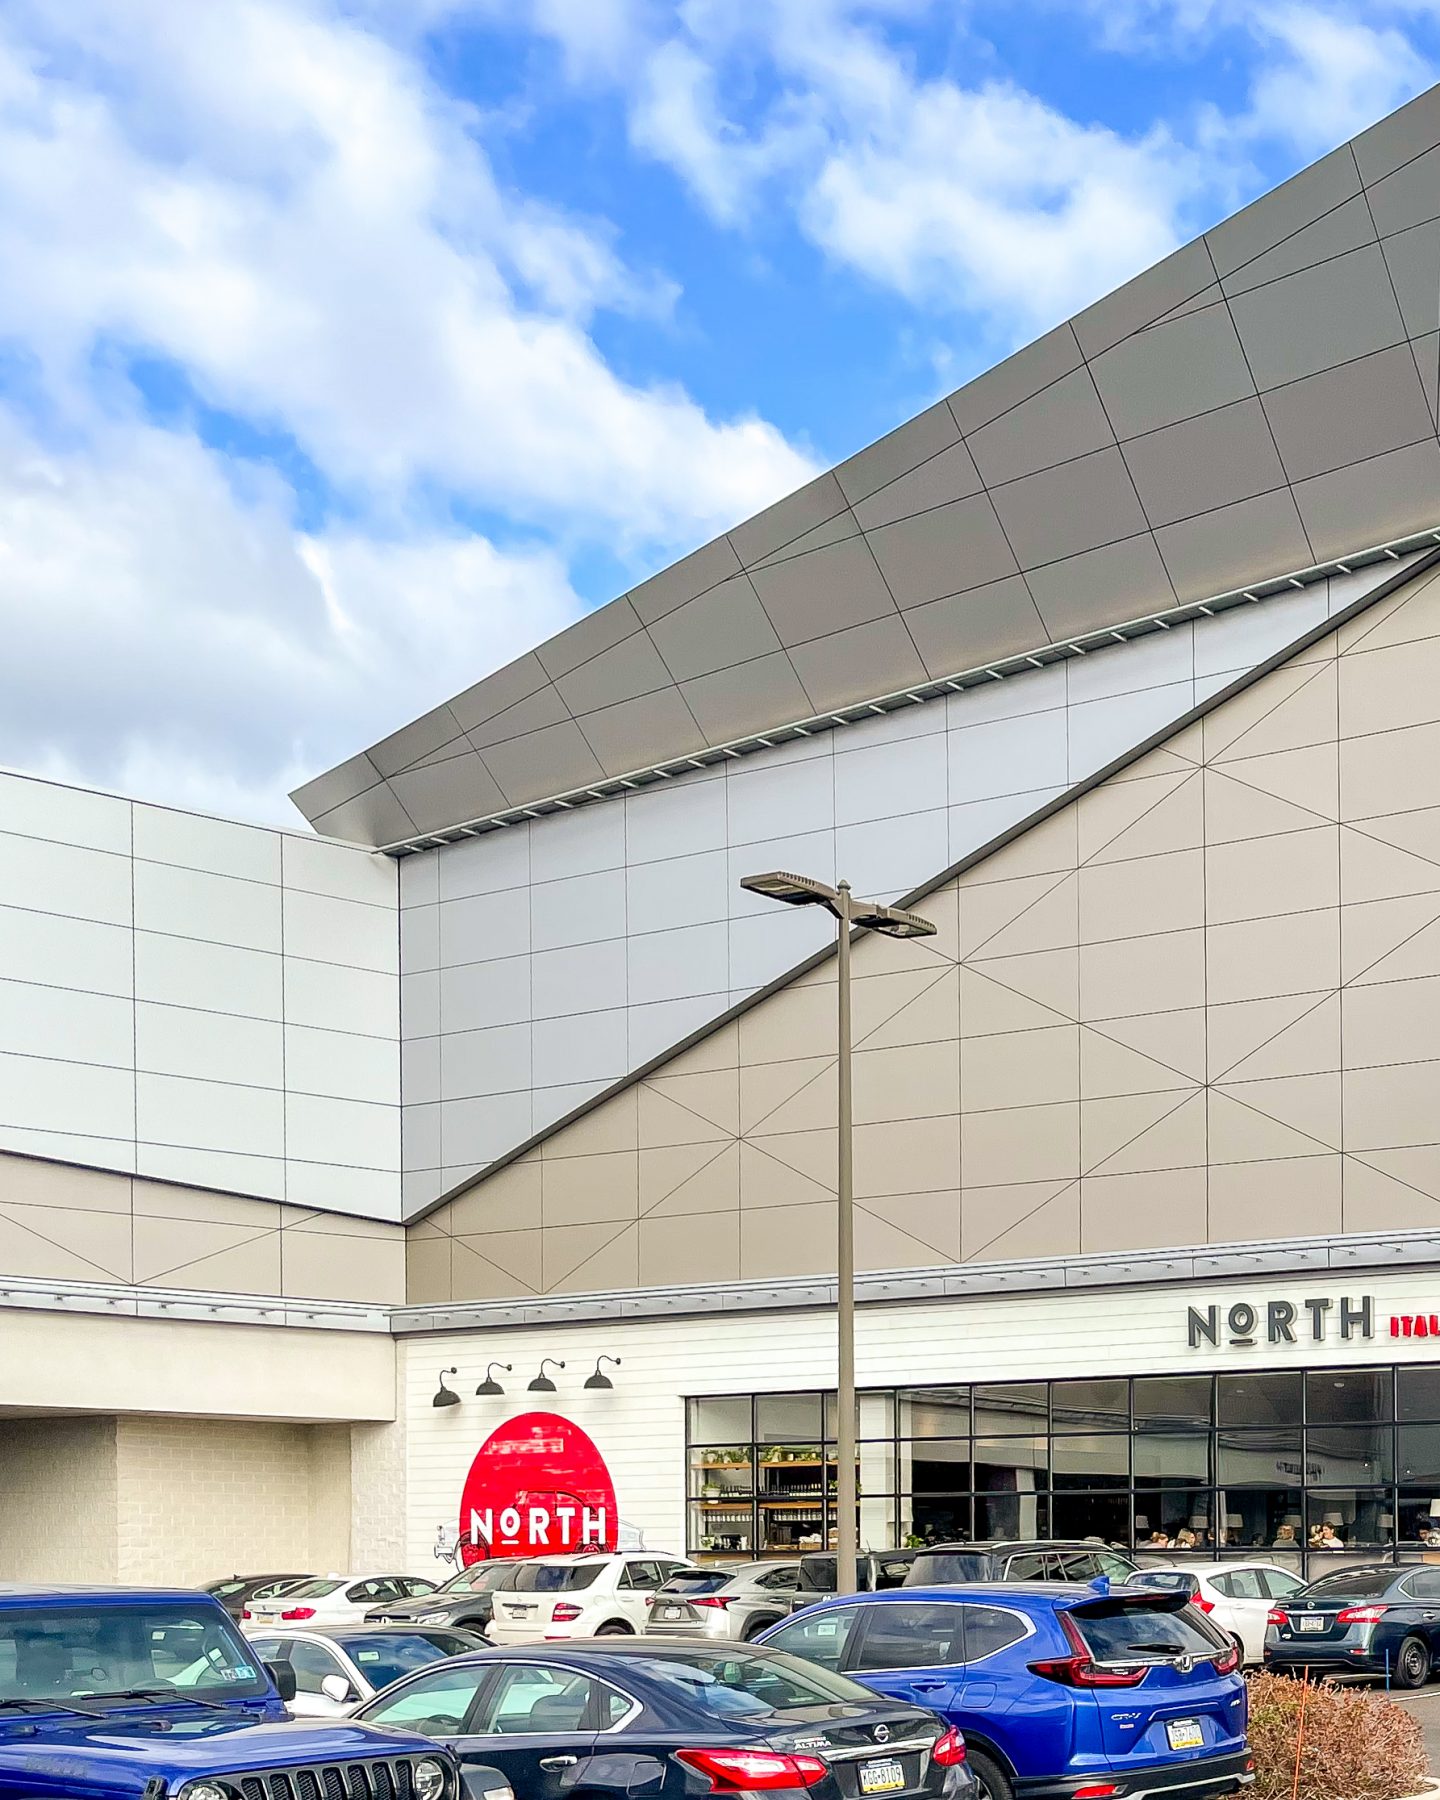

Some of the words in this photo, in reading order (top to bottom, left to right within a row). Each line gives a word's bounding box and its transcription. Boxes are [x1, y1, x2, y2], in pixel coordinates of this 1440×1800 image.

[1187, 1295, 1375, 1348] NORTH
[469, 1506, 606, 1546] NORTH
[794, 1740, 832, 1751] ALTIMA
